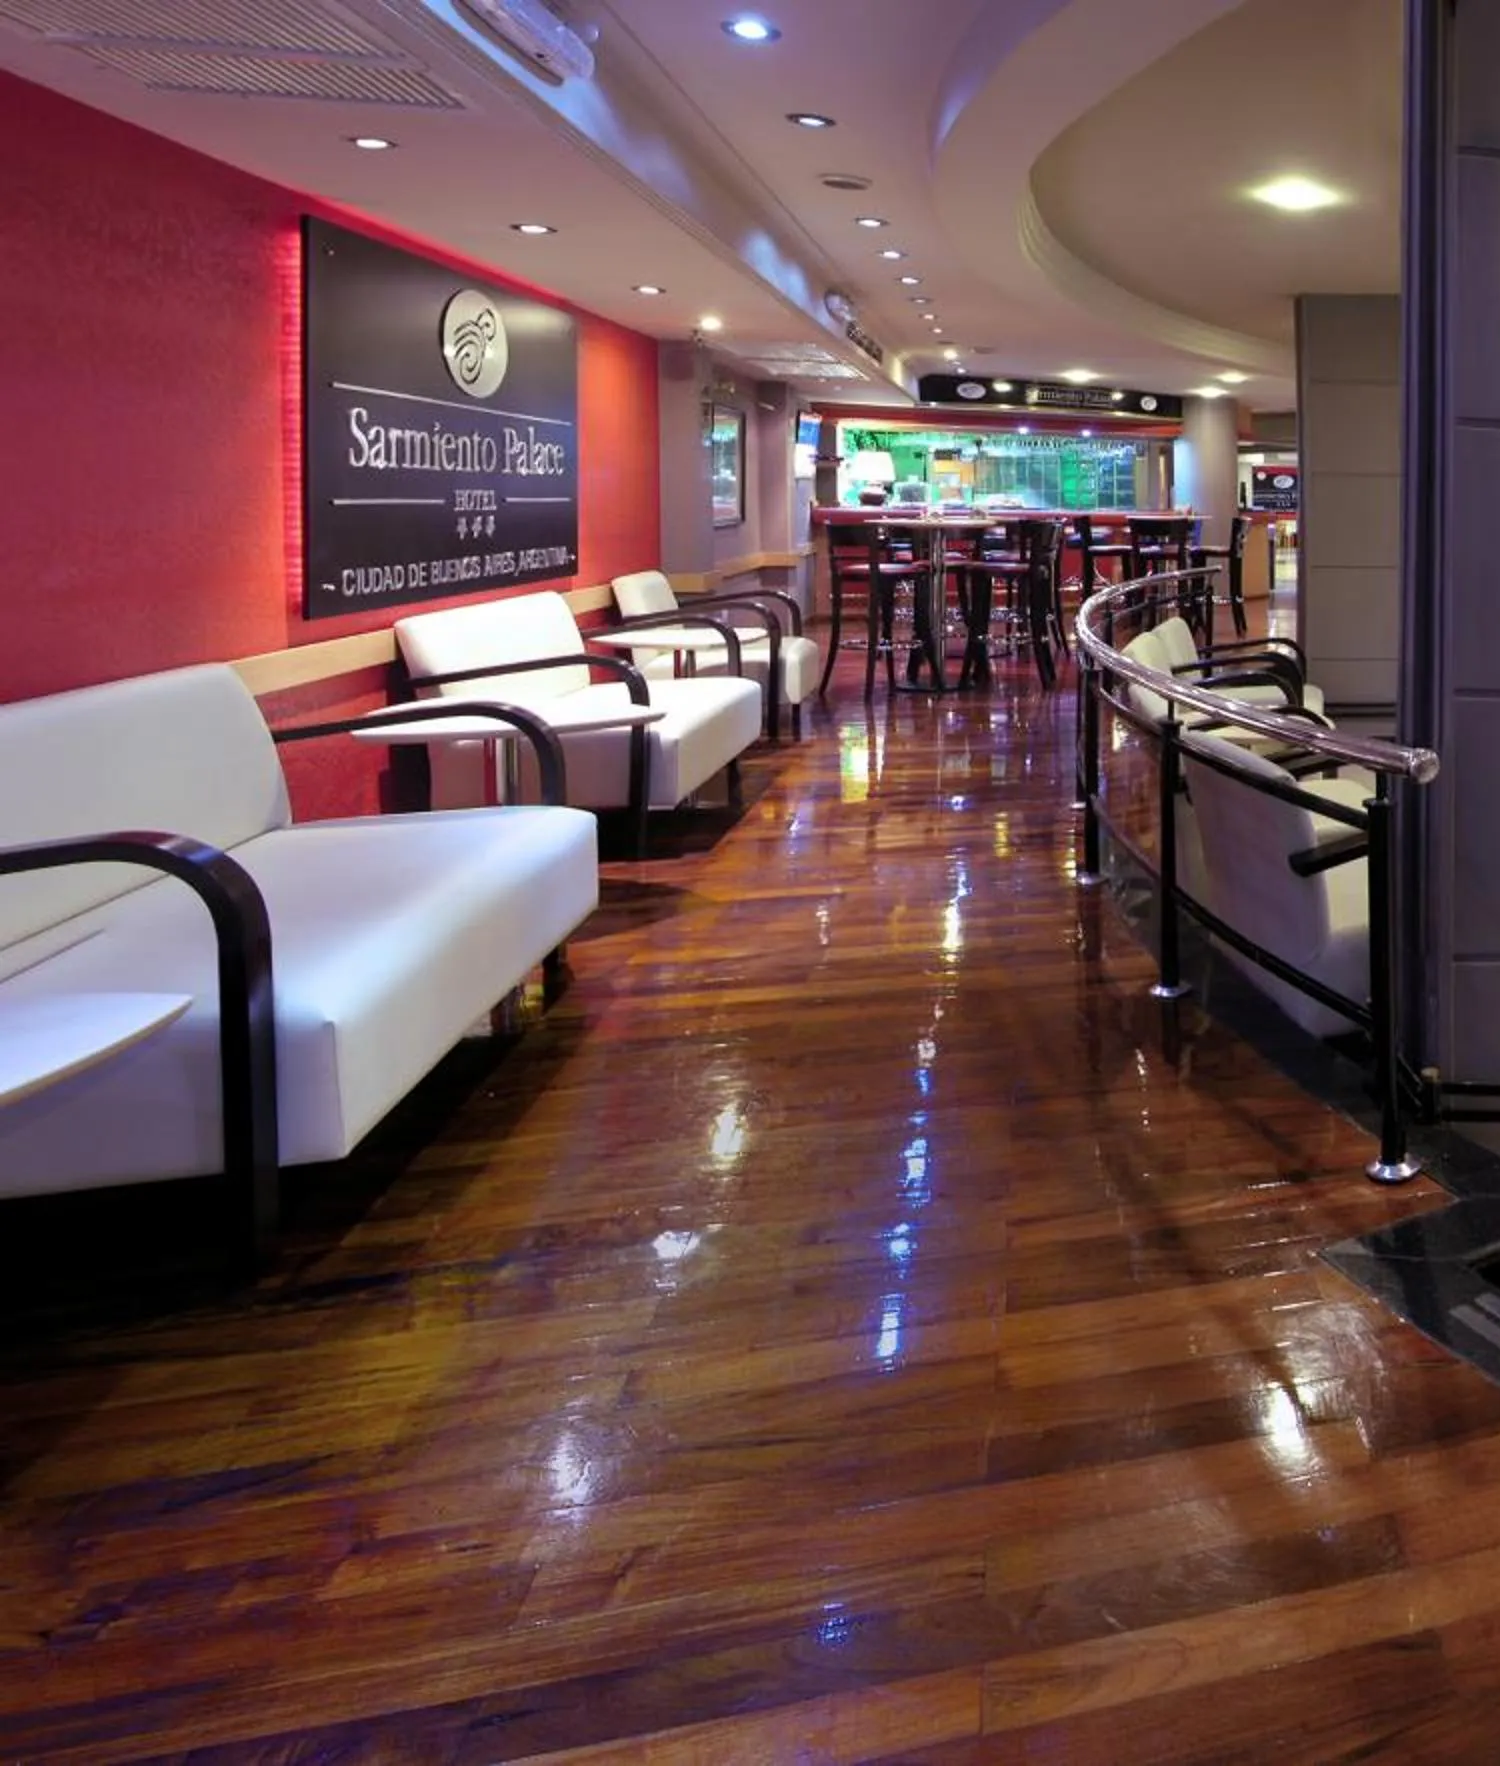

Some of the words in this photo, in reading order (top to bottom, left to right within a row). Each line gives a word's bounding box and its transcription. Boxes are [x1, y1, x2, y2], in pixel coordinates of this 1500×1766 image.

[349, 407, 497, 473] Sarmiento
[502, 426, 564, 475] Palace
[454, 490, 496, 511] HOTEL
[342, 566, 404, 596] CIUDAD
[408, 562, 427, 588] DE
[430, 556, 481, 583] BUENOS
